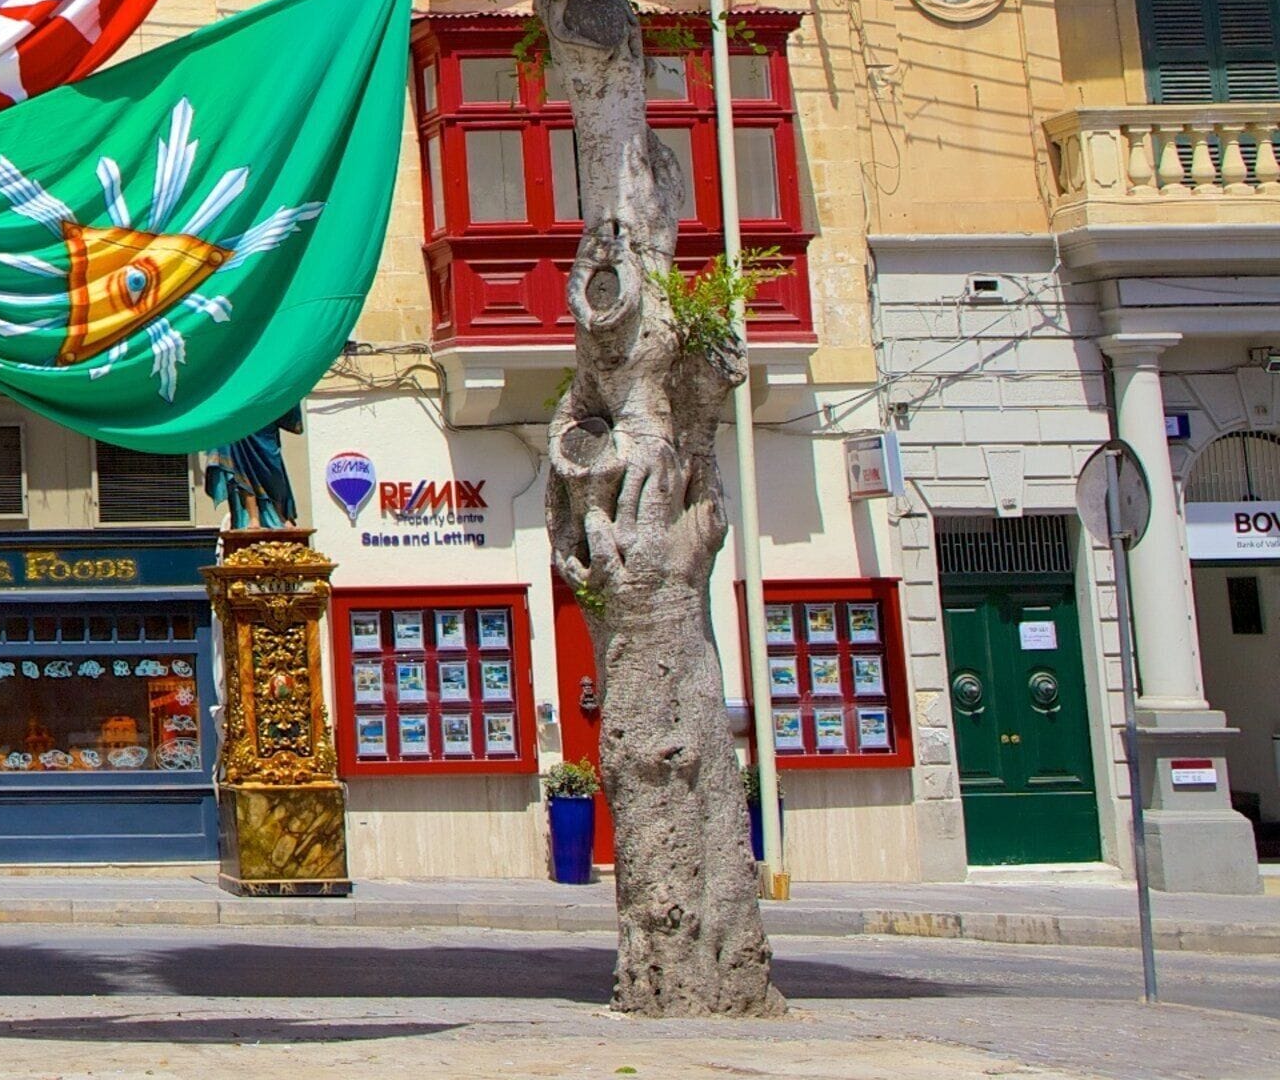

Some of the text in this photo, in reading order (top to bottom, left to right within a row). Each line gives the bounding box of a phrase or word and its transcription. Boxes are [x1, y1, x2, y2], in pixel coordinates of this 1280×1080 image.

[331, 459, 370, 473] RE/MAX
[379, 480, 488, 511] RE/MAX
[397, 512, 484, 526] Property Centre
[361, 531, 485, 546] Sales and Letting
